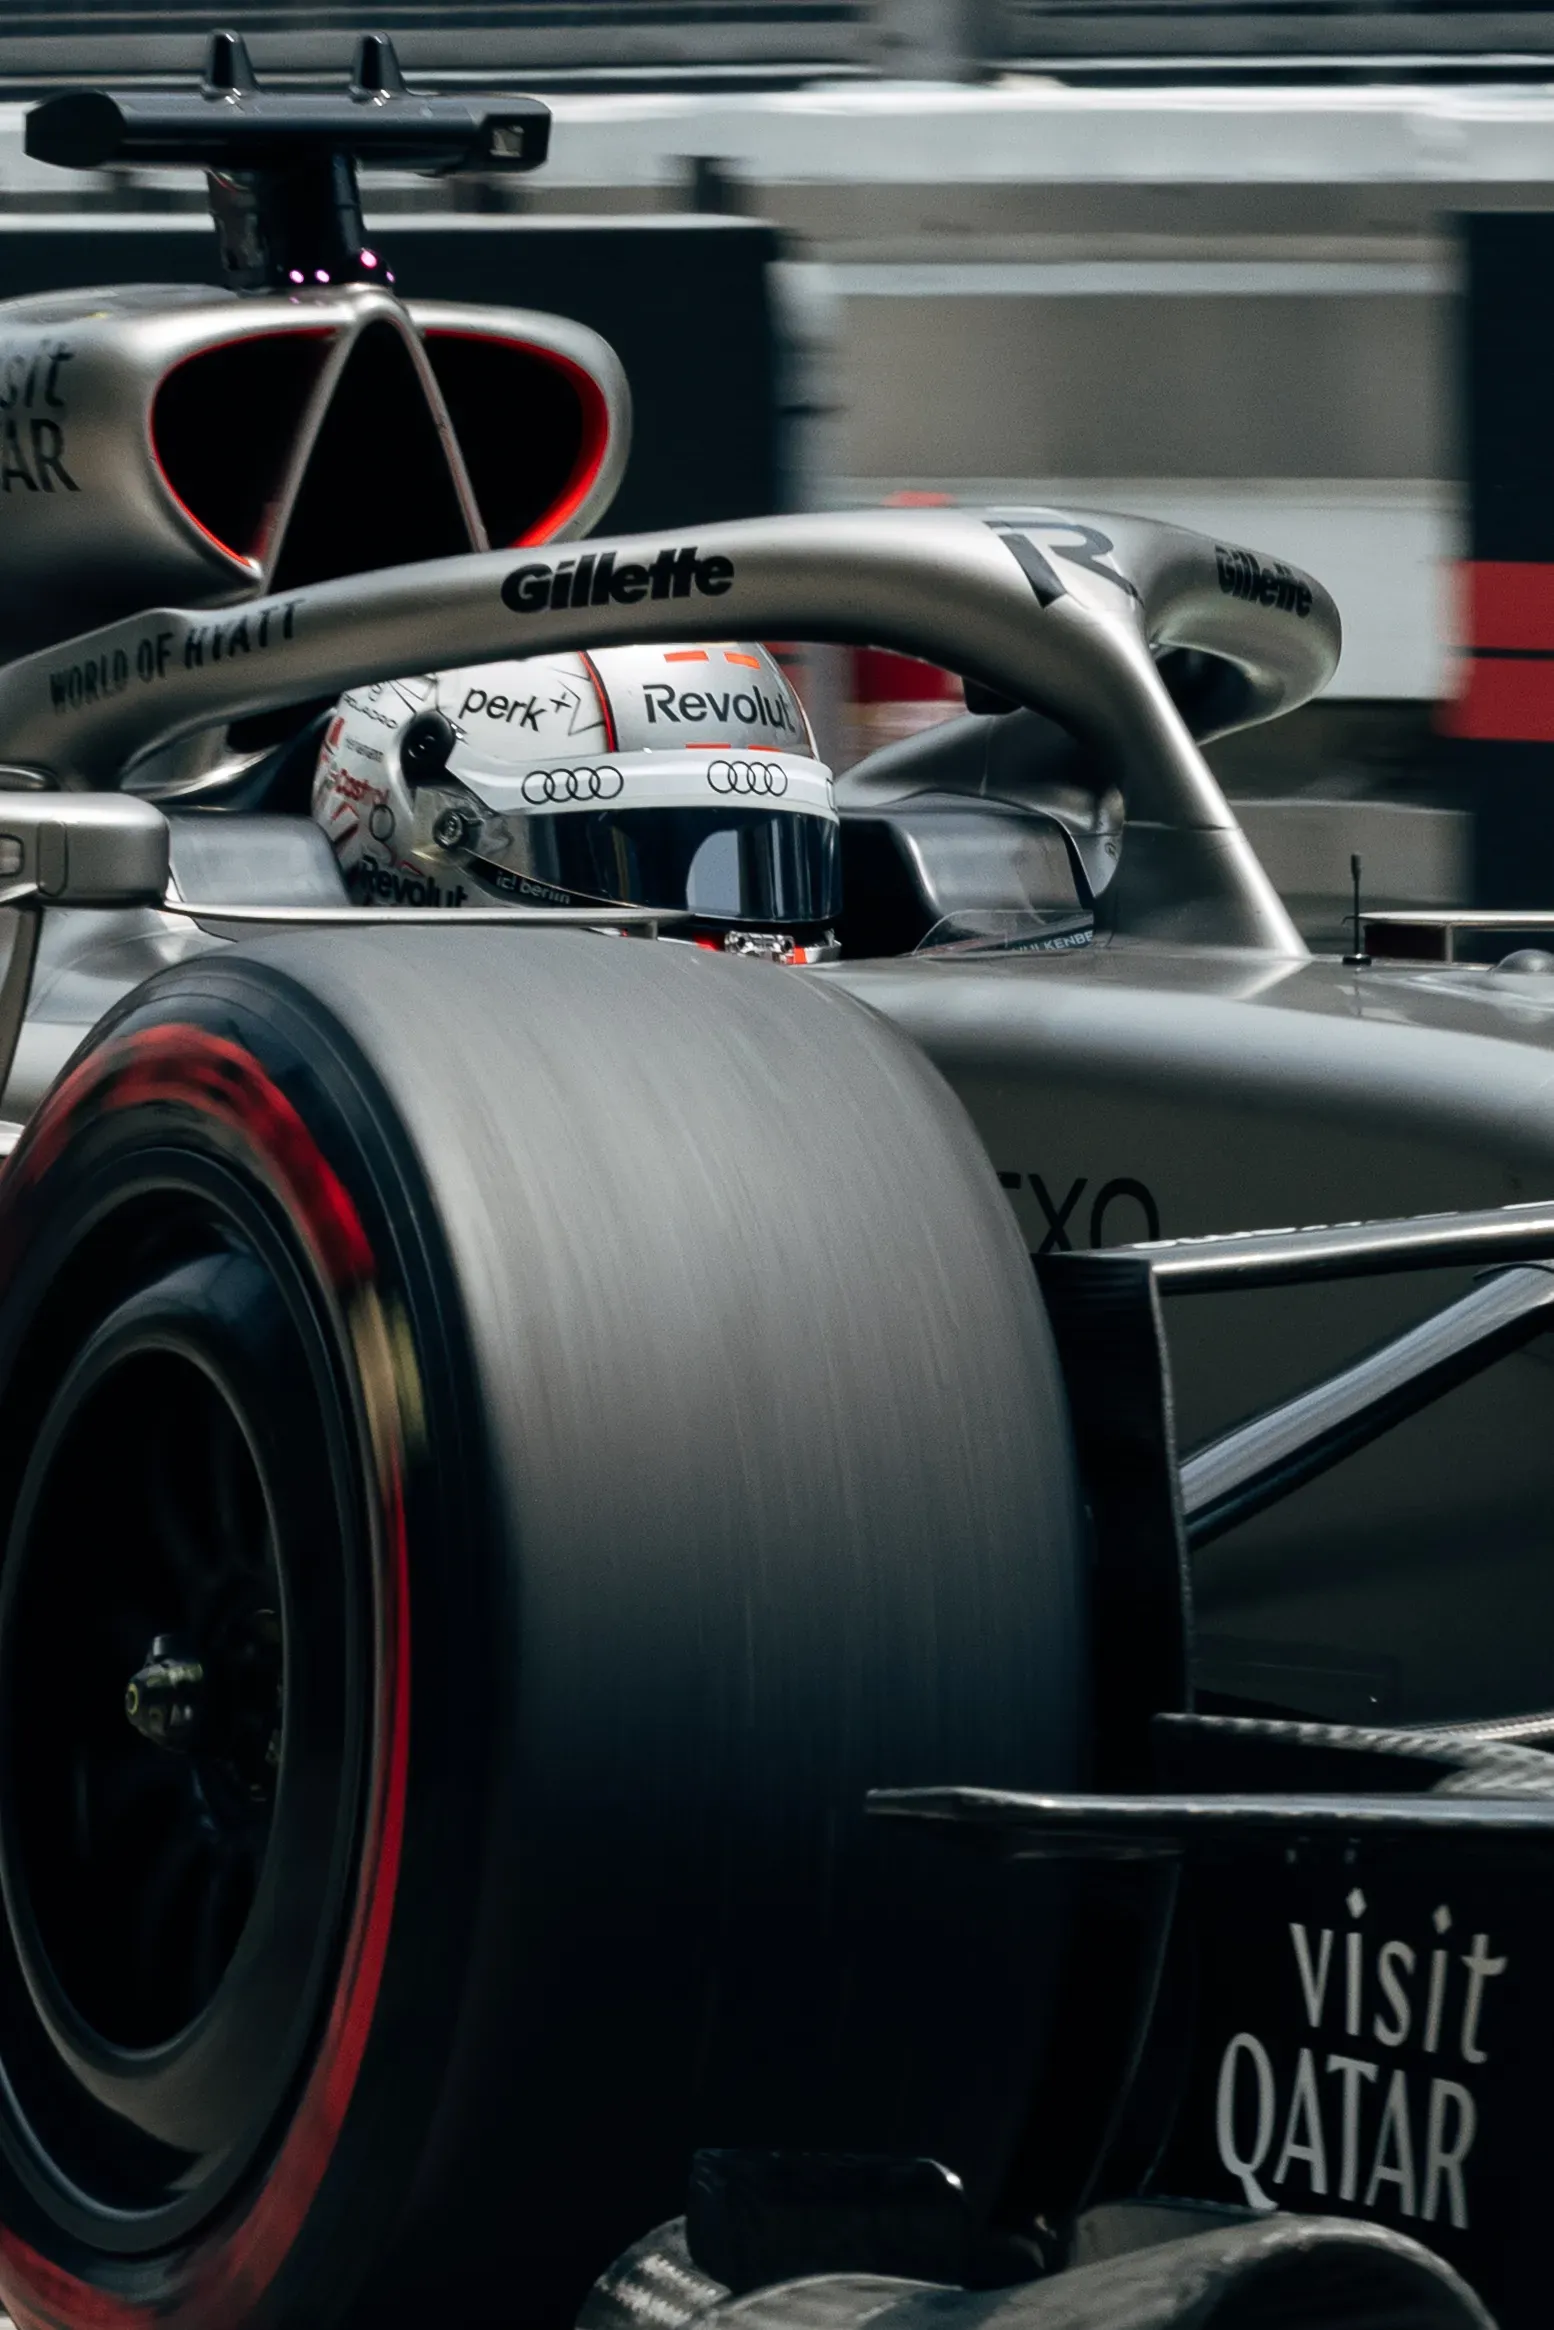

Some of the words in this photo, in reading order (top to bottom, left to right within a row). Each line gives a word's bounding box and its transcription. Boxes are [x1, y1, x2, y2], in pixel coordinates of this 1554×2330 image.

[501, 546, 735, 614] Gillette
[1213, 544, 1313, 619] Gillette
[50, 648, 128, 716] WORLD
[137, 632, 175, 684] OF
[184, 598, 306, 670] HYATT
[642, 684, 797, 733] Revolut
[997, 1172, 1160, 1252] XO
[1289, 1887, 1508, 2065] visit
[1216, 2032, 1478, 2230] QATAR
